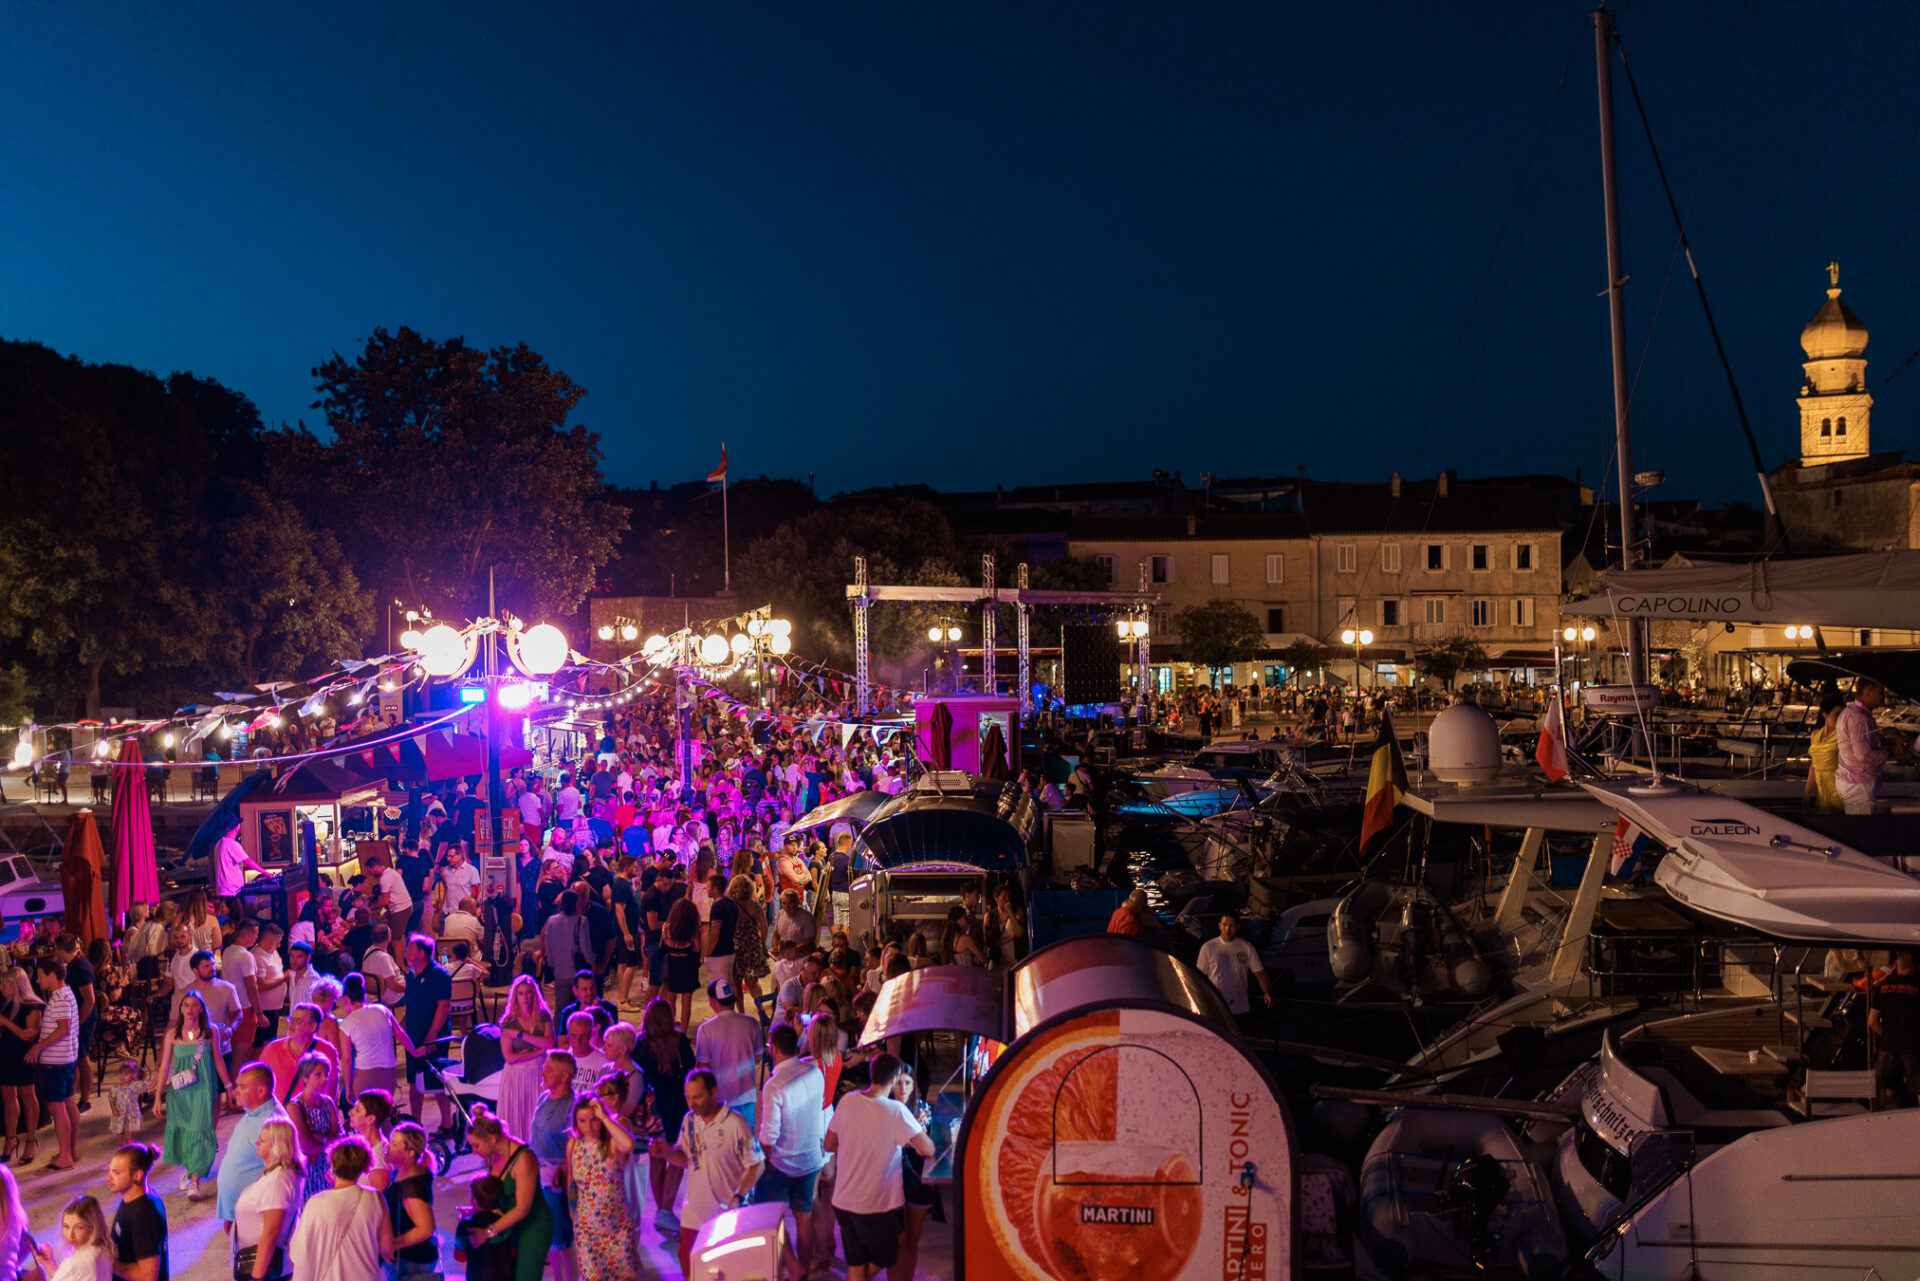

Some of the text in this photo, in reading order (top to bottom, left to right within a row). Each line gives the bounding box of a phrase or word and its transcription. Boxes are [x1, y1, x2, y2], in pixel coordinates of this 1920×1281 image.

[1617, 596, 1741, 614] CAPOLINO
[1599, 692, 1652, 704] Raymaine
[1690, 825, 1761, 836] GALEON
[1229, 1092, 1251, 1175] TONIC
[1083, 1207, 1153, 1224] MARTINI
